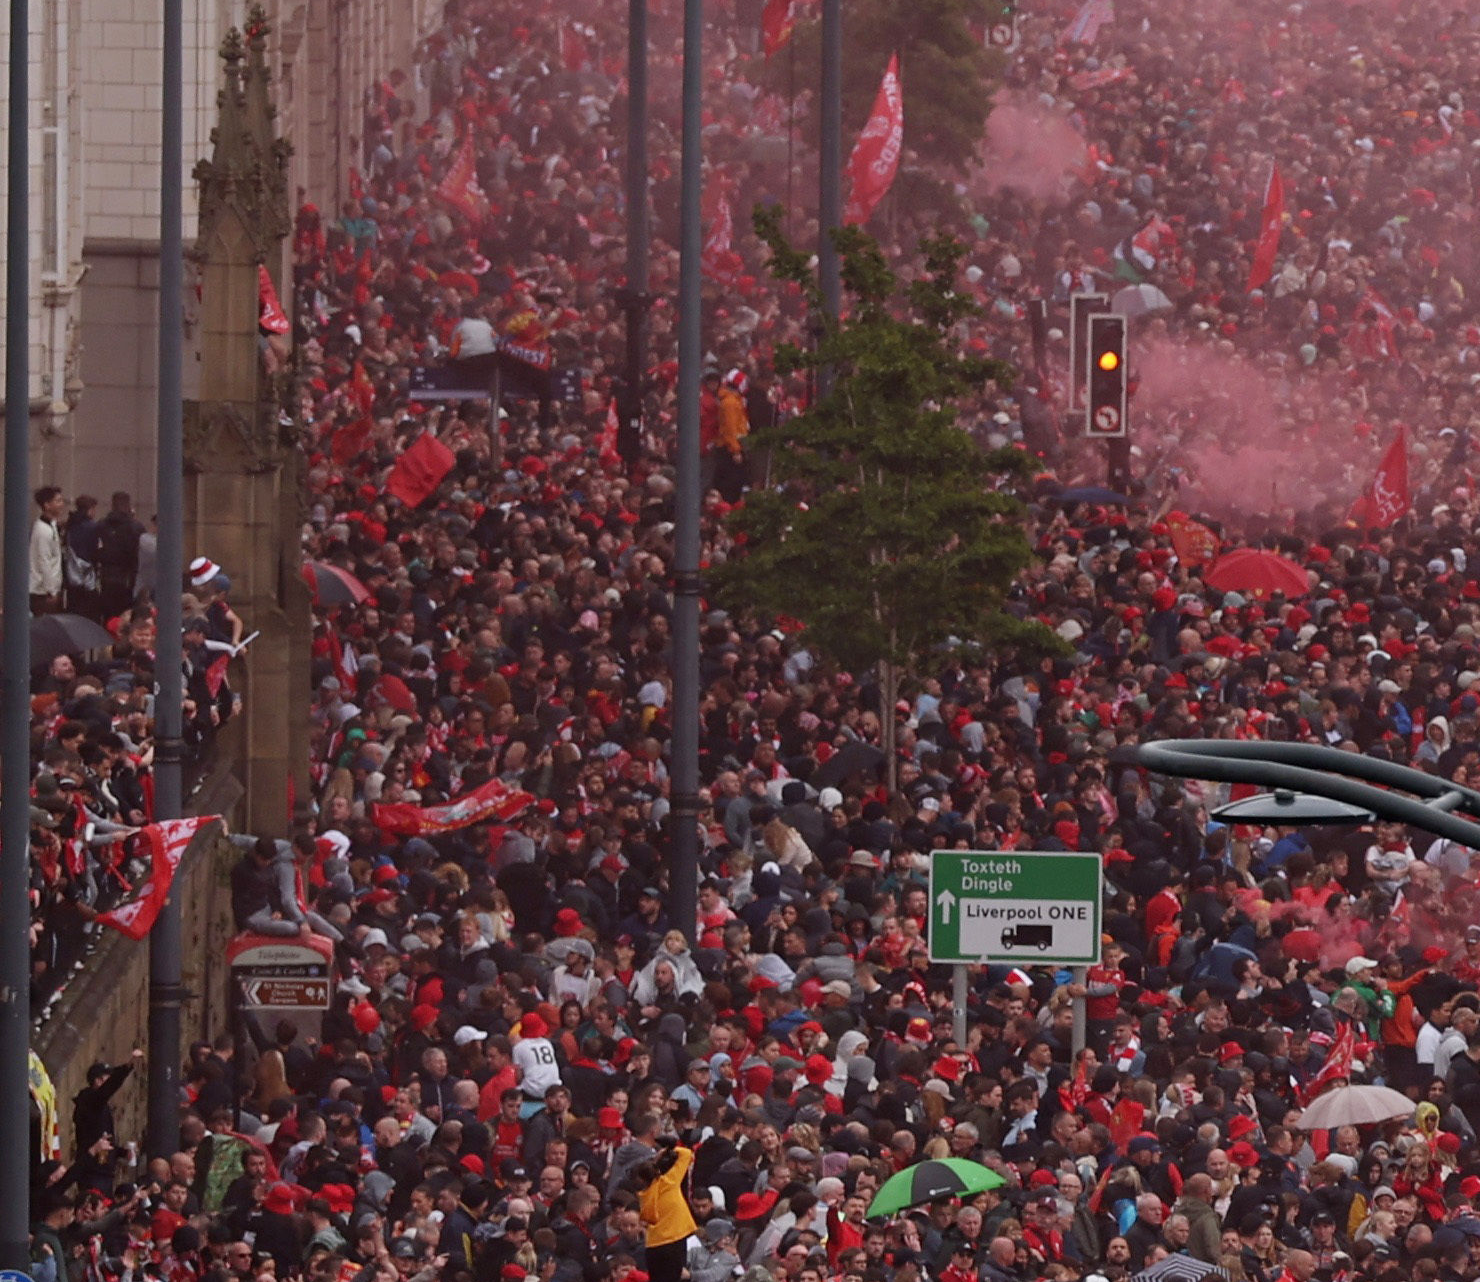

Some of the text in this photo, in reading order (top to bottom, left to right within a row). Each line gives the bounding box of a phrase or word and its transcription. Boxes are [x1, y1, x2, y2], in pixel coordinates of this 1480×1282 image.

[961, 859, 1021, 874] Toxteth
[961, 877, 1013, 894] Dingle
[967, 905, 1088, 920] Liverpool ONE
[271, 990, 297, 998] Church
[531, 1046, 554, 1066] 18
